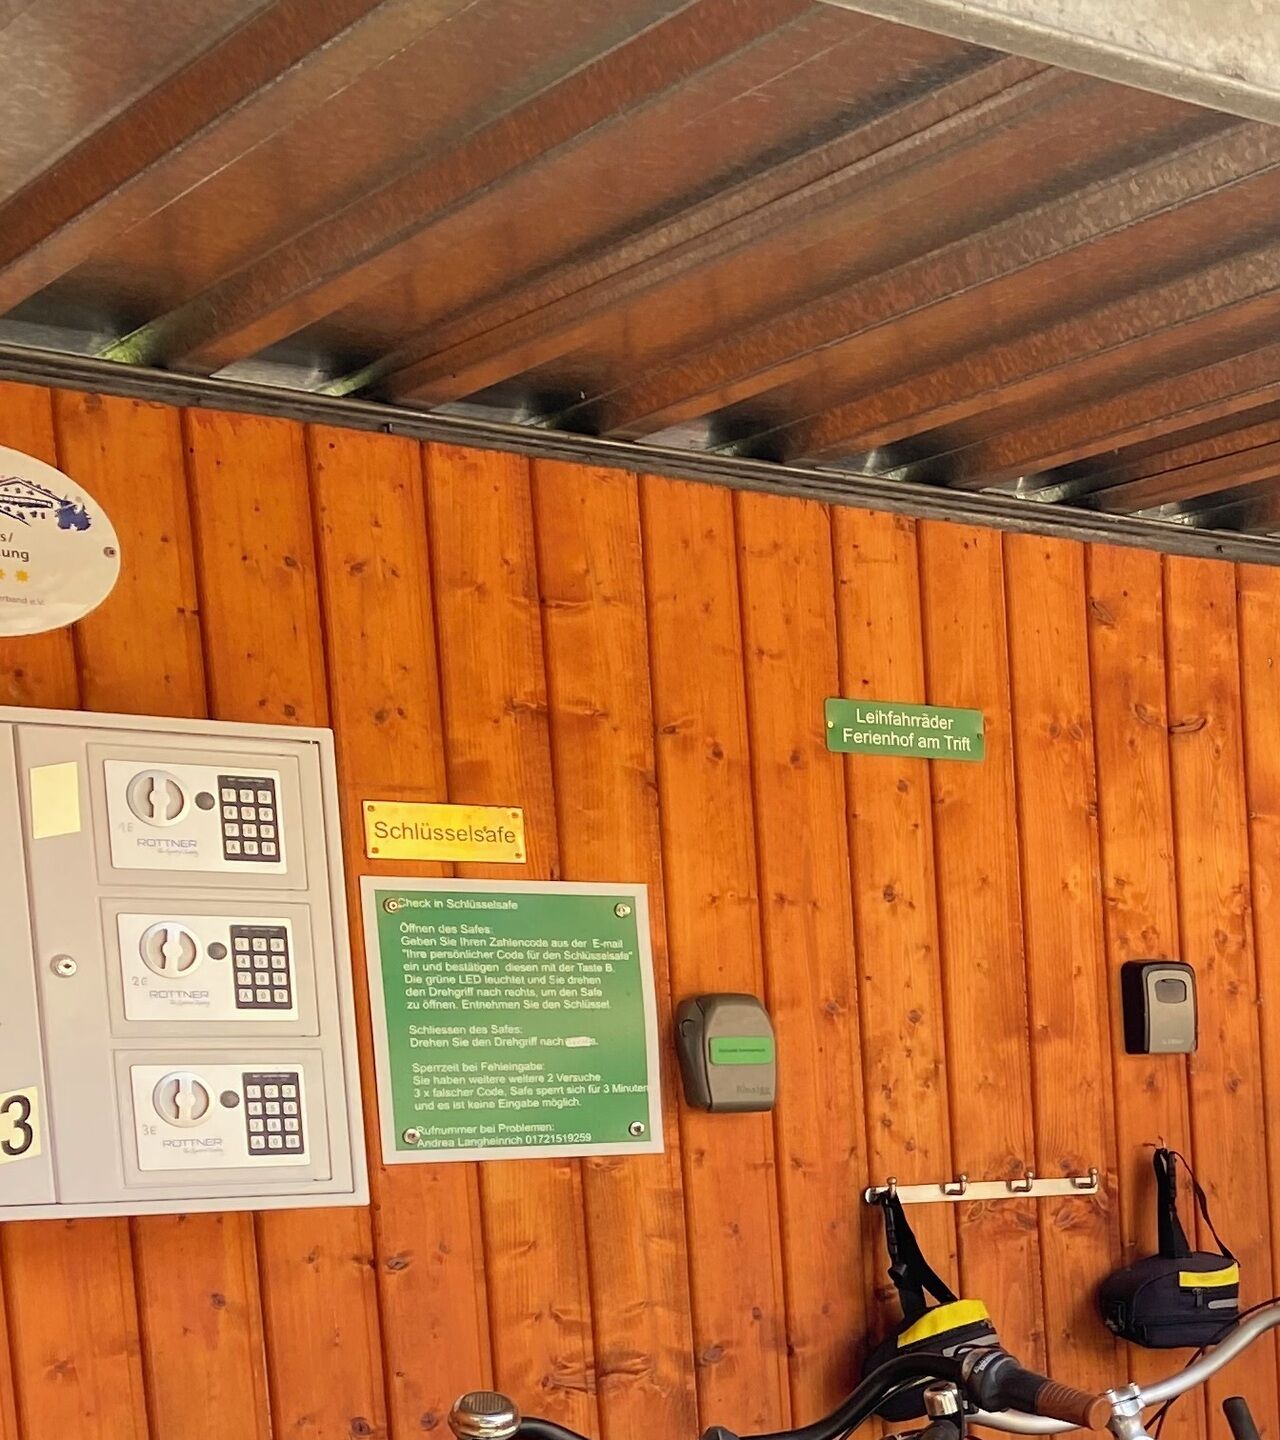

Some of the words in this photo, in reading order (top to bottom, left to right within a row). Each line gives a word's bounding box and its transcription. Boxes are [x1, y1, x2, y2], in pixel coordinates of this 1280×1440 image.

[0, 549, 29, 562] ung
[856, 709, 954, 730] Leihfahrräder
[843, 728, 913, 748] Ferienhof
[918, 736, 940, 749] am
[944, 735, 971, 752] Trift
[374, 820, 516, 844] Schlüsselsafe
[137, 838, 197, 848] ROTTNER
[398, 898, 431, 908] Check
[435, 899, 443, 909] in
[446, 899, 518, 910] Schlüsselsafe
[399, 922, 435, 934] Öffnen
[438, 924, 457, 934] des
[401, 937, 436, 947] Geben
[440, 938, 457, 946] Sie
[460, 938, 486, 947] Ihren
[551, 940, 569, 948] aus
[572, 939, 587, 948] der
[593, 939, 623, 949] E-mail
[496, 950, 523, 960] Code
[527, 950, 540, 960] für
[543, 951, 561, 960] den
[403, 963, 419, 972] ein
[422, 963, 442, 972] und
[505, 963, 538, 972] diesen
[542, 963, 556, 972] mit
[559, 963, 574, 972] der
[577, 963, 602, 973] Taste
[405, 975, 422, 984] Die
[459, 975, 481, 984] LED
[529, 976, 546, 984] und
[549, 976, 565, 985] Sie
[568, 976, 601, 985] drehen
[149, 991, 209, 999] ROTTNER
[406, 988, 425, 996] den
[429, 987, 473, 999] Drehgriff
[477, 988, 501, 996] nach
[560, 988, 577, 996] den
[580, 988, 602, 996] Safe
[407, 1001, 420, 1009] zu
[523, 1000, 539, 1009] Sie
[543, 1000, 561, 1009] den
[469, 1025, 488, 1034] des
[410, 1038, 449, 1048] Drehen
[452, 1037, 469, 1047] Sie
[472, 1037, 491, 1047] den
[494, 1036, 537, 1049] Drehgriff
[540, 1037, 563, 1046] nach
[462, 1062, 478, 1072] bei
[413, 1075, 430, 1085] Sie
[433, 1074, 465, 1085] haben
[547, 1073, 553, 1083] 2
[414, 1088, 420, 1098] 3
[510, 1086, 533, 1096] Safe
[567, 1085, 585, 1095] sich
[588, 1084, 600, 1094] für
[603, 1084, 609, 1093] 3
[414, 1101, 435, 1111] und
[438, 1102, 450, 1111] es
[453, 1100, 465, 1110] ist
[498, 1098, 539, 1111] Eingabe
[0, 1094, 33, 1156] 3
[480, 1124, 495, 1134] bei
[162, 1137, 223, 1148] ROTTNER
[417, 1138, 455, 1148] Andrea
